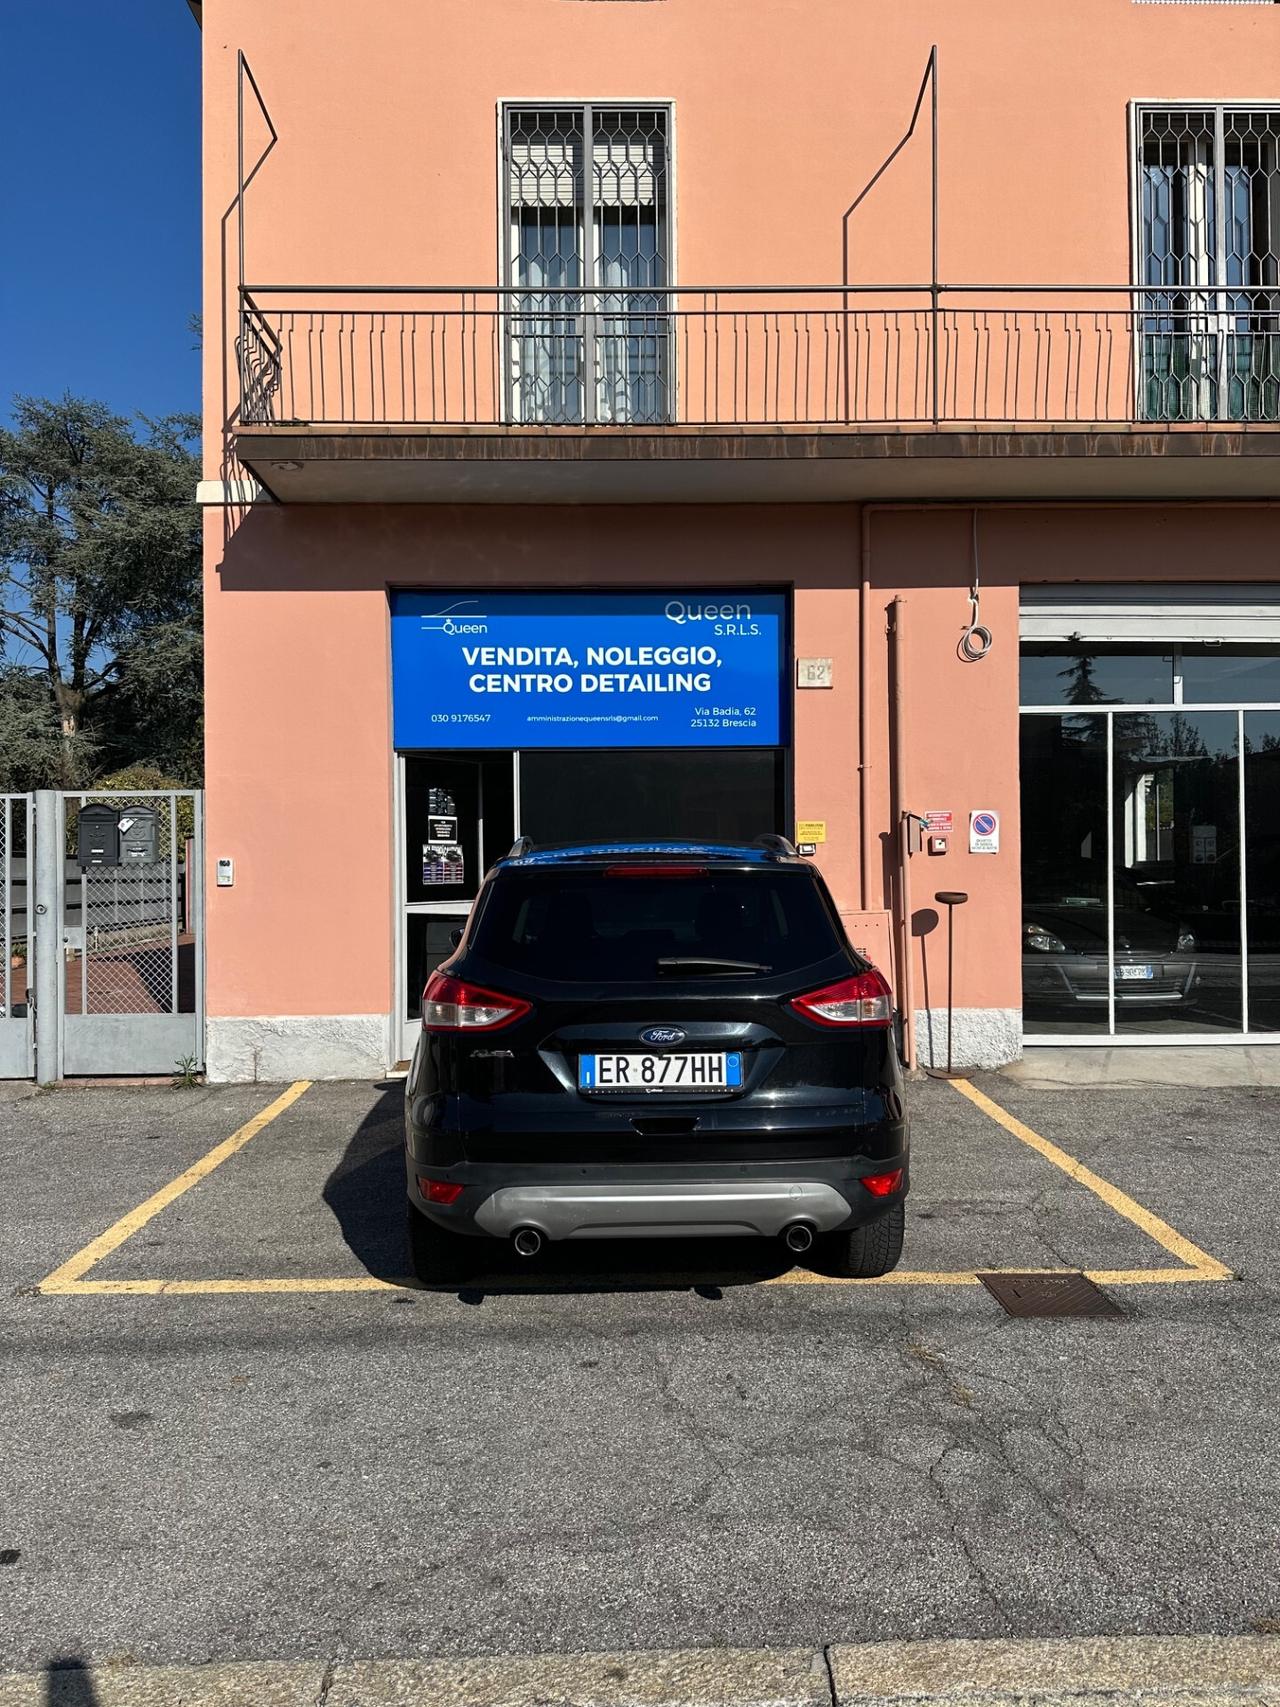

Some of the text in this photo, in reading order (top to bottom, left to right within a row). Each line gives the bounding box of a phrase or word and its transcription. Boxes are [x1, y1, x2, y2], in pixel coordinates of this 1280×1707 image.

[664, 600, 751, 624] Queen
[443, 620, 488, 635] Queen
[713, 623, 762, 636] S.R.L.S.
[461, 646, 723, 668] VENDITA, NOLEGGIO,
[469, 673, 711, 693] CENTRO DETAILING
[431, 714, 491, 723] 030 9176547
[527, 714, 659, 723] amministrazionequeensrls@gmail.com
[694, 707, 757, 717] Via Badia, 62
[690, 719, 757, 728] 25132 Brescia
[650, 1030, 676, 1041] Ford
[599, 1056, 630, 1084] ER
[641, 1056, 723, 1084] 877HH
